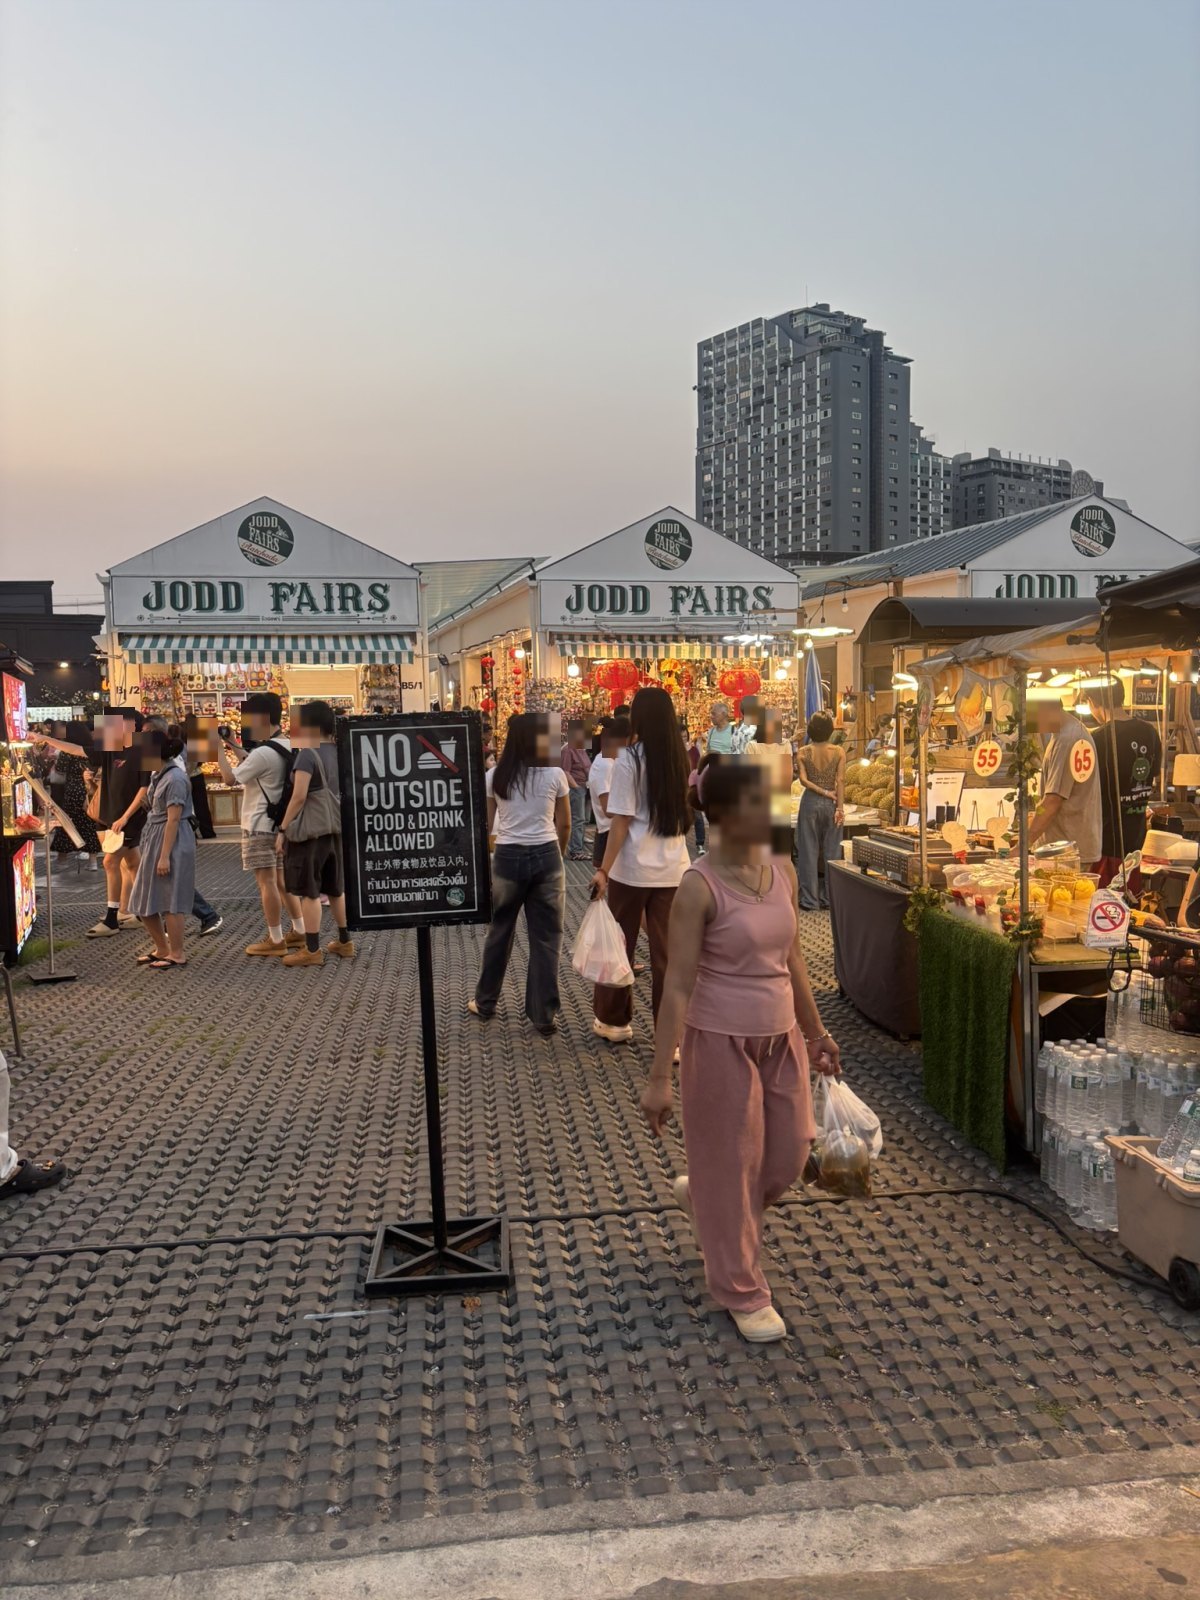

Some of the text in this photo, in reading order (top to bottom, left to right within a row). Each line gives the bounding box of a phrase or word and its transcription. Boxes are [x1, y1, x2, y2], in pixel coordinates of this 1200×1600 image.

[249, 515, 278, 528] JODD
[1080, 509, 1104, 520] JODD
[249, 526, 280, 552] FAIRS
[654, 522, 680, 534] JODD
[1080, 519, 1104, 544] FAIRS
[654, 532, 680, 557] FAIRS
[142, 580, 391, 615] JODD FAIRS
[565, 583, 774, 616] JODD FAIRS
[401, 681, 422, 690] B5/1
[360, 732, 412, 779] NO
[977, 748, 999, 768] 55
[1074, 748, 1092, 773] 65
[363, 779, 464, 811] OUTSIDE
[364, 809, 465, 832] FOOD & DRINK
[365, 832, 435, 853] ALLOWED
